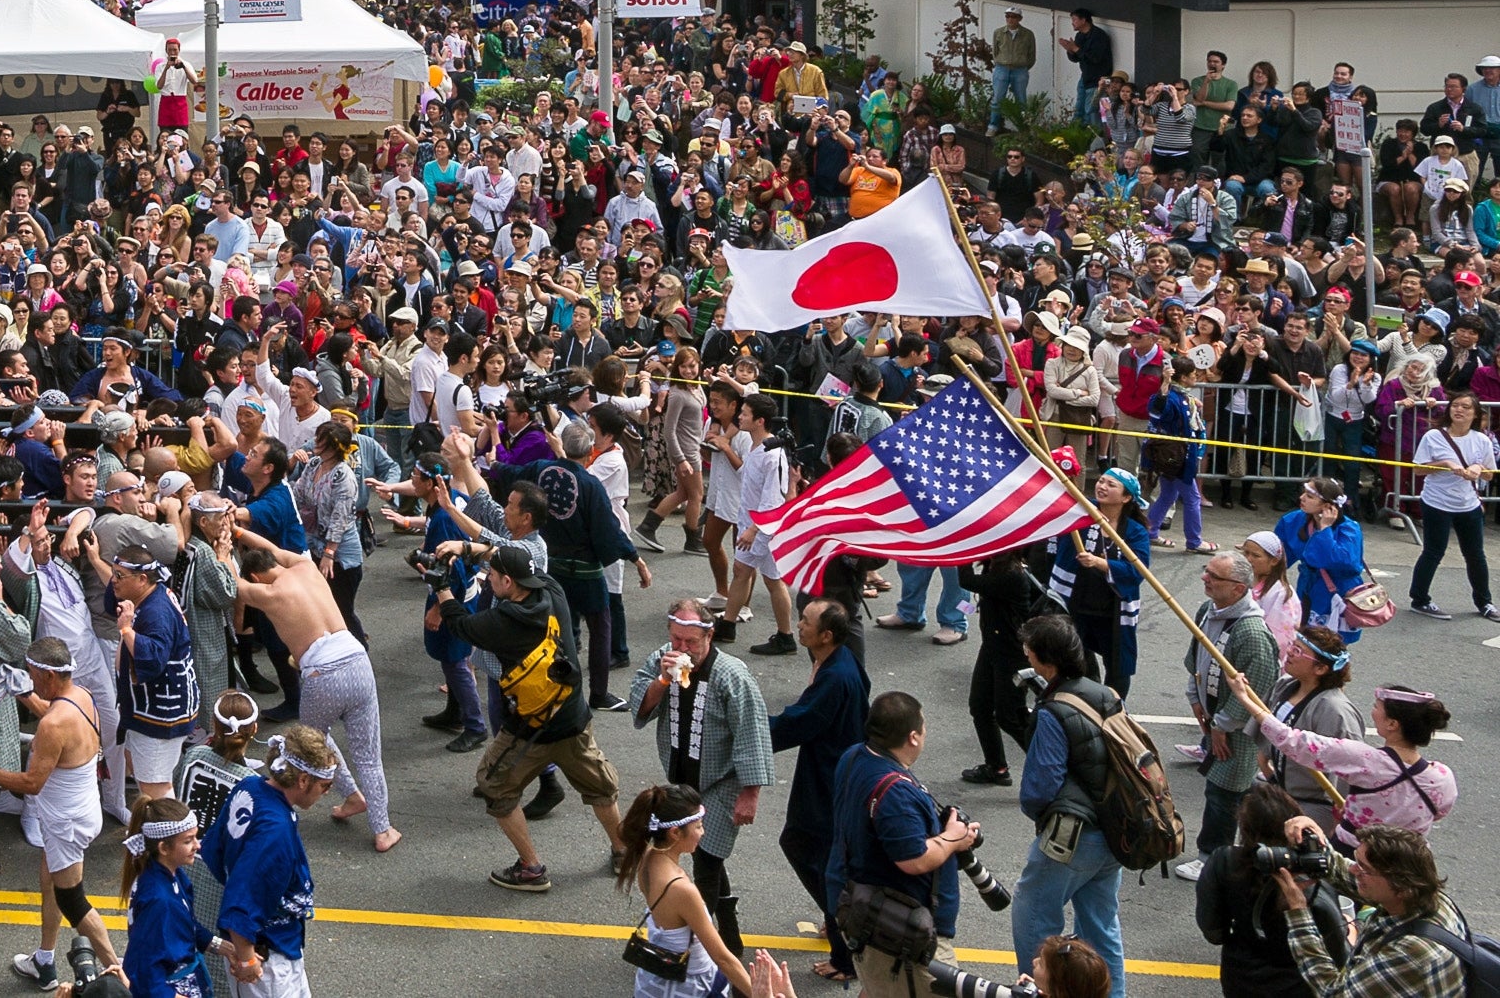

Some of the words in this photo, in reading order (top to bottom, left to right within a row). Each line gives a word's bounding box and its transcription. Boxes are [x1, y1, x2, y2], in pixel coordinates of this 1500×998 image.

[263, 67, 296, 79] Vegetable
[236, 83, 304, 103] Calbee
[242, 103, 259, 112] San
[261, 103, 298, 112] Francisco
